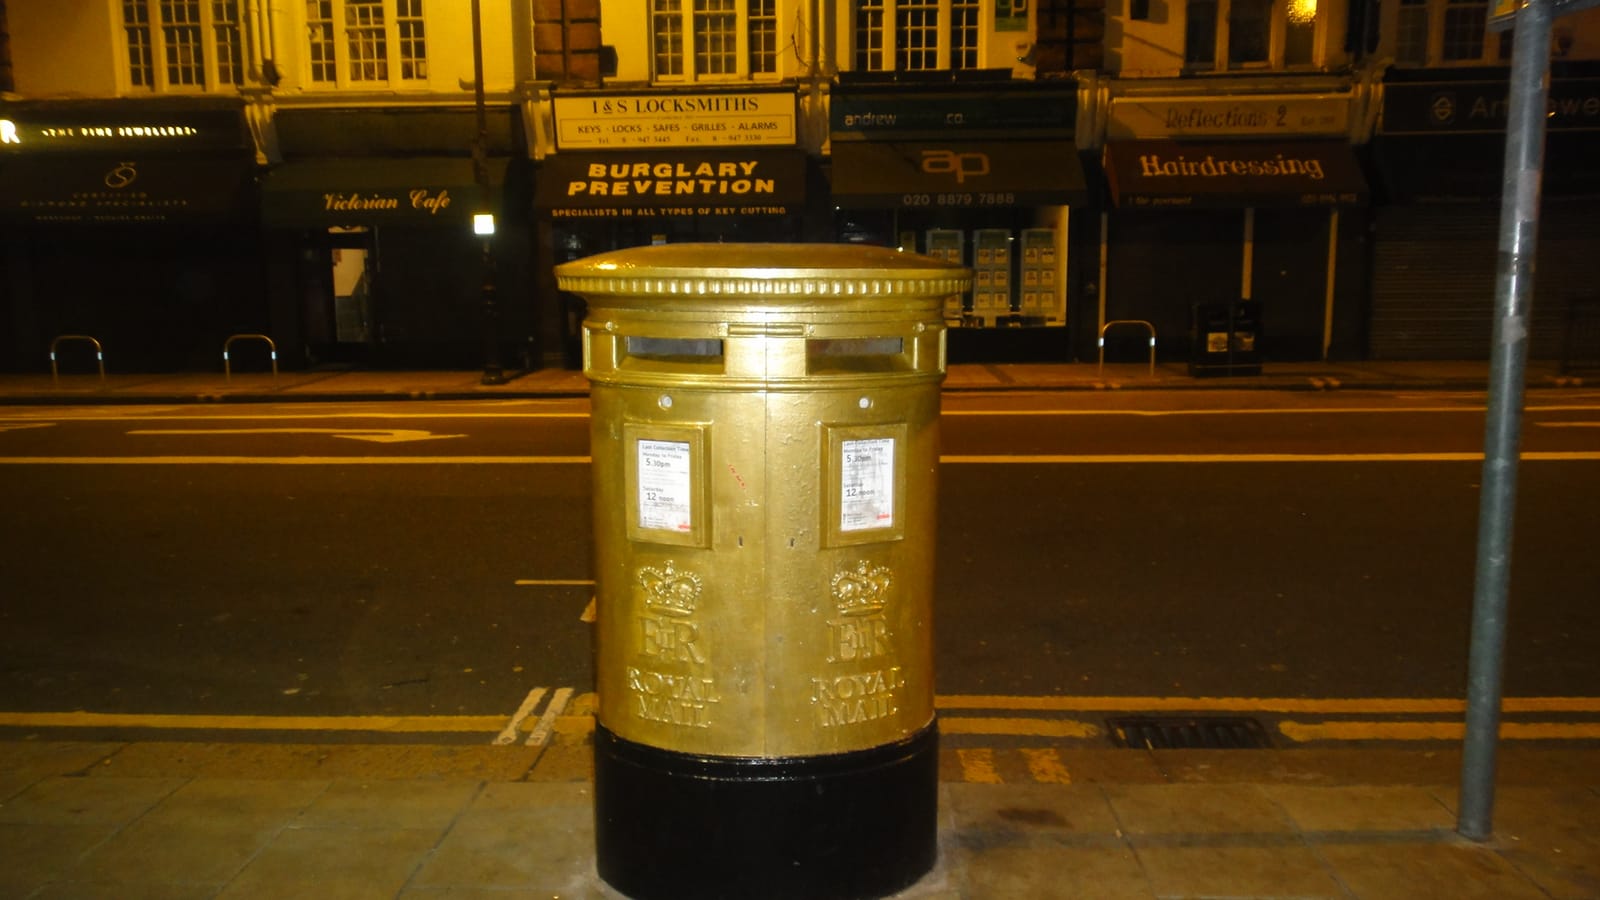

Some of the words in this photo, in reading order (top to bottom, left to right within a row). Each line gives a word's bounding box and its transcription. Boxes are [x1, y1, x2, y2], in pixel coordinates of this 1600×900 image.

[602, 101, 613, 114] &
[617, 99, 628, 113] S
[635, 97, 759, 113] LOCKSMITHS
[844, 112, 897, 127] andrew
[1276, 103, 1288, 128] 2
[577, 125, 601, 134] KEYS
[612, 124, 642, 133] LOCKS
[652, 123, 680, 132] SAFES
[691, 122, 727, 132] GRILLES
[738, 121, 778, 131] ALARMS
[588, 161, 758, 178] BURGLARY
[921, 150, 990, 183] ap
[1139, 153, 1325, 180] Hairdressing
[567, 178, 775, 196] PREVENTION
[323, 193, 398, 210] Victorian
[903, 194, 931, 206] 020
[937, 193, 972, 206] 8879
[979, 193, 1015, 205] 7888
[551, 208, 618, 217] SPECIALISTS
[621, 208, 632, 216] IN
[638, 207, 656, 216] ALL
[660, 207, 693, 216] TYPES
[698, 207, 710, 215] OF
[715, 207, 736, 215] KEY
[740, 206, 786, 215] CUTTING
[646, 492, 656, 501] 12
[846, 488, 857, 497] 12
[626, 665, 721, 703] ROYAL
[810, 666, 905, 704] ROYAL
[637, 694, 712, 728] MAIL
[822, 693, 898, 727] MAIL
